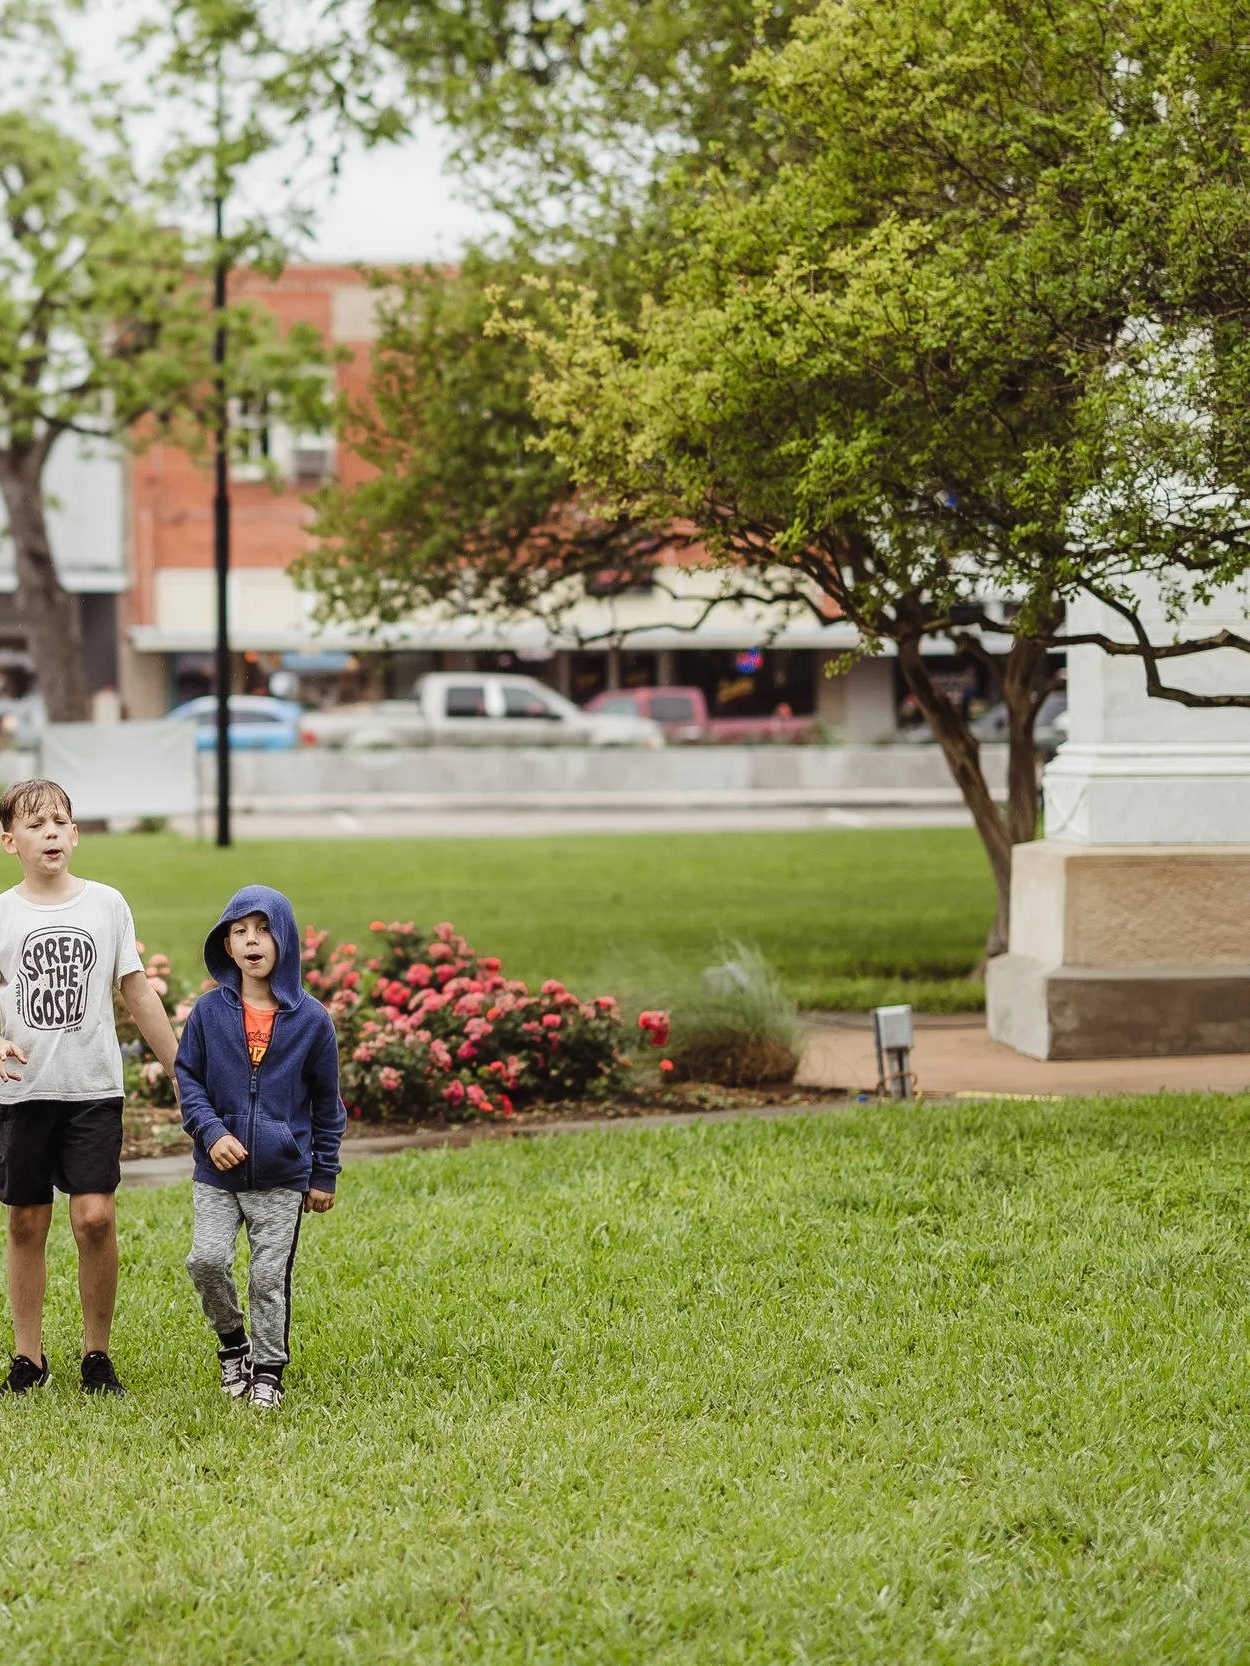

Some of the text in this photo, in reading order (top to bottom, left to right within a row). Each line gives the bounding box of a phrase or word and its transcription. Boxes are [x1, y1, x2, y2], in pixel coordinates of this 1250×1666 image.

[22, 936, 93, 981] SPREAD
[45, 964, 78, 988] THE
[30, 984, 83, 1026] GOSPL
